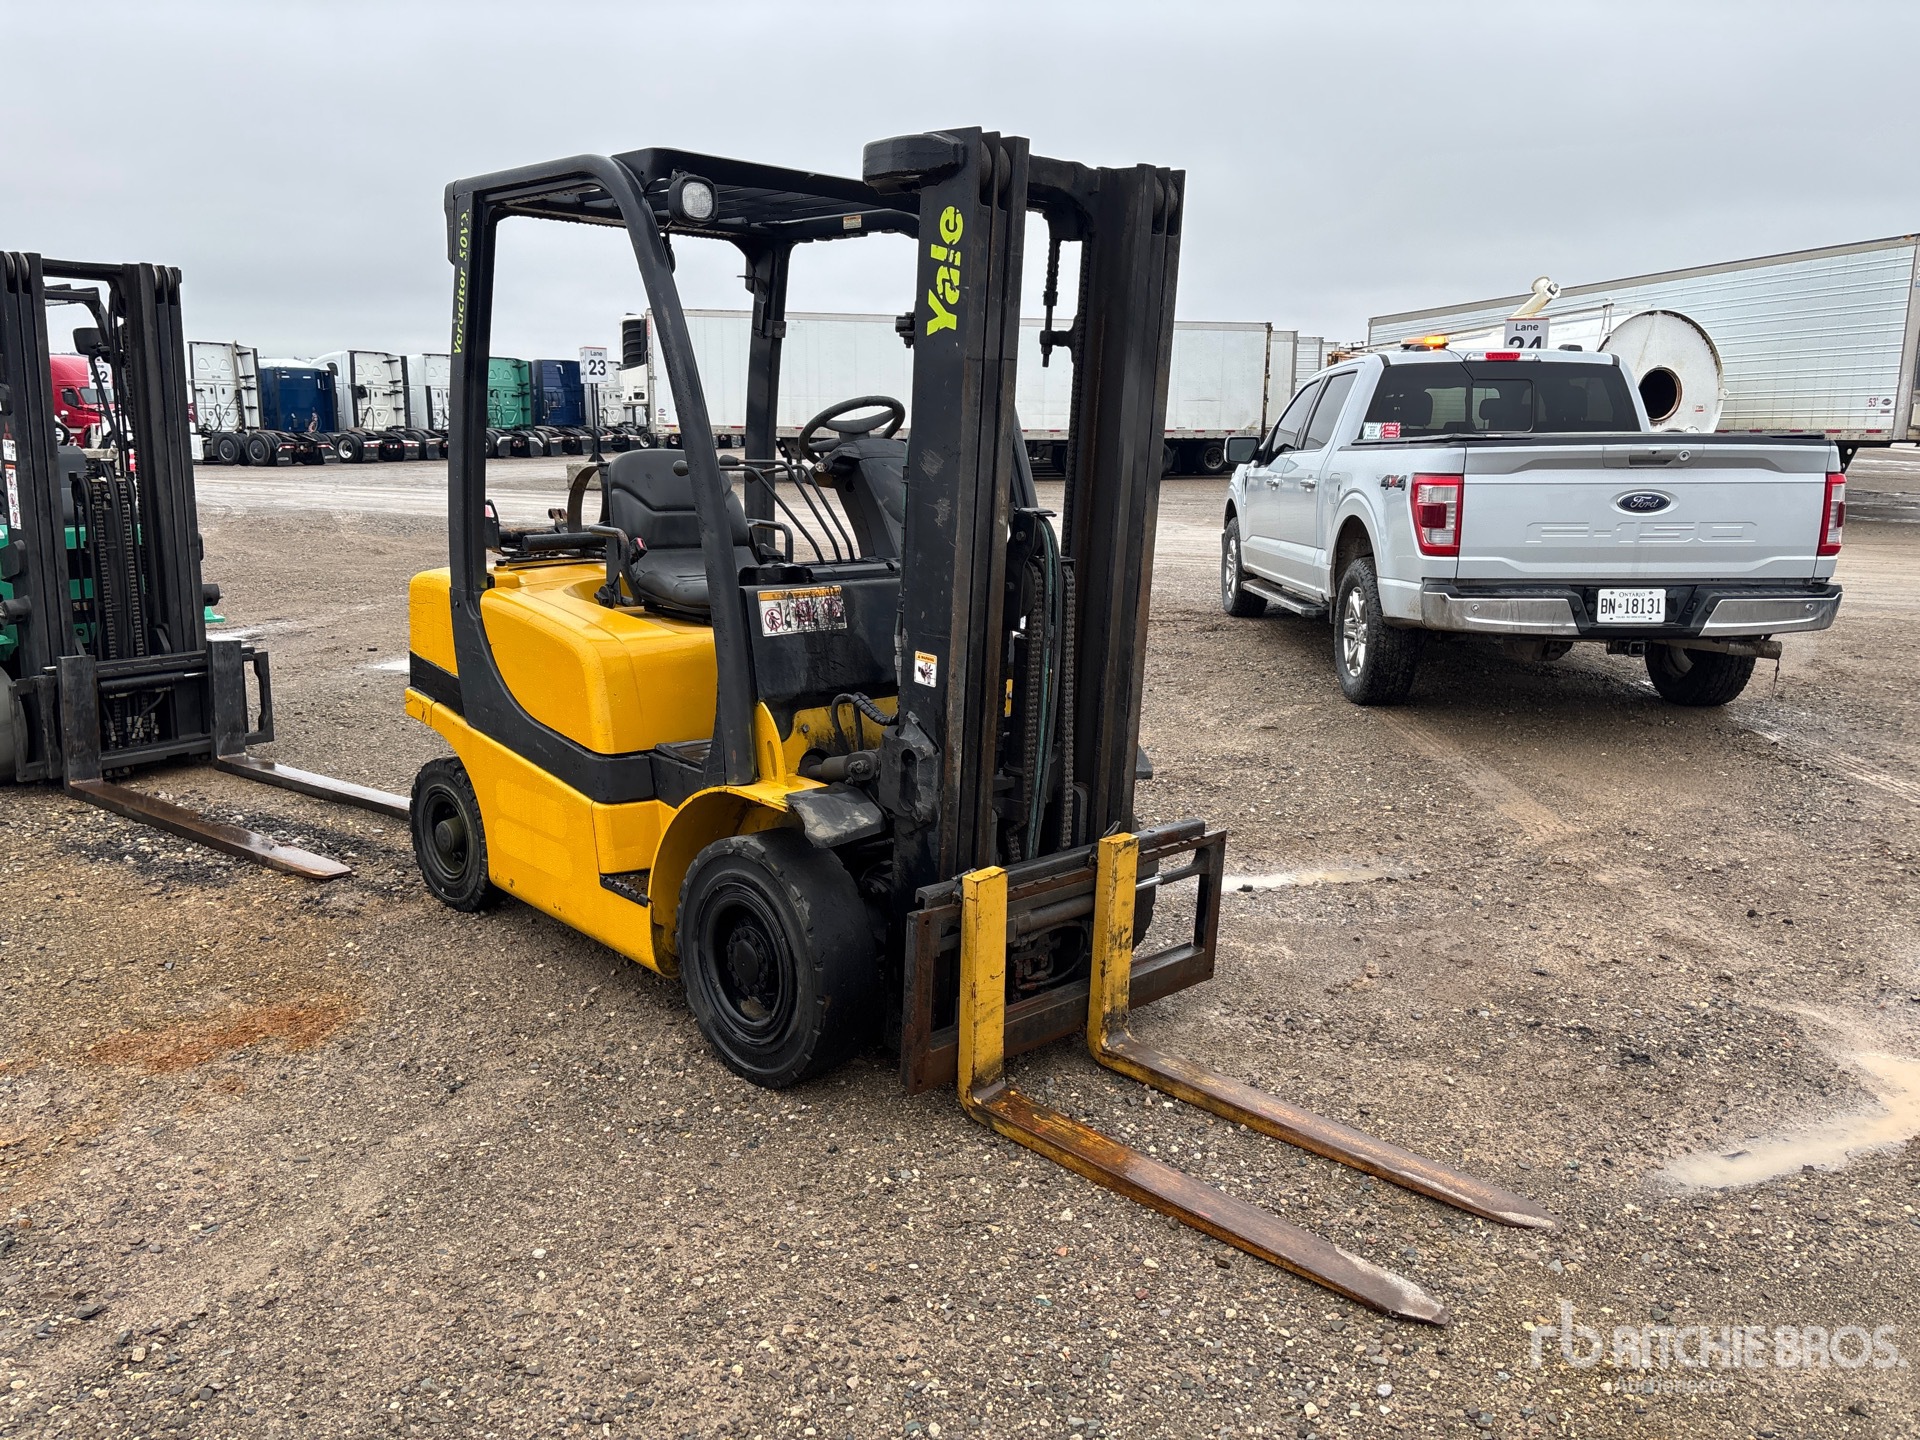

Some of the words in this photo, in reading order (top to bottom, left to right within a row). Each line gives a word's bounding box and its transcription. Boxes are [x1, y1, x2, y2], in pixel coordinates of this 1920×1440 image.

[927, 206, 963, 336] Yale
[454, 267, 466, 353] Veracitor
[1515, 323, 1539, 331] Lane
[1508, 335, 1542, 349] 24
[588, 359, 606, 376] 23
[1630, 495, 1660, 508] Ford
[1525, 521, 1758, 543] F-150
[1601, 598, 1616, 614] BN
[1624, 598, 1661, 614] 18131
